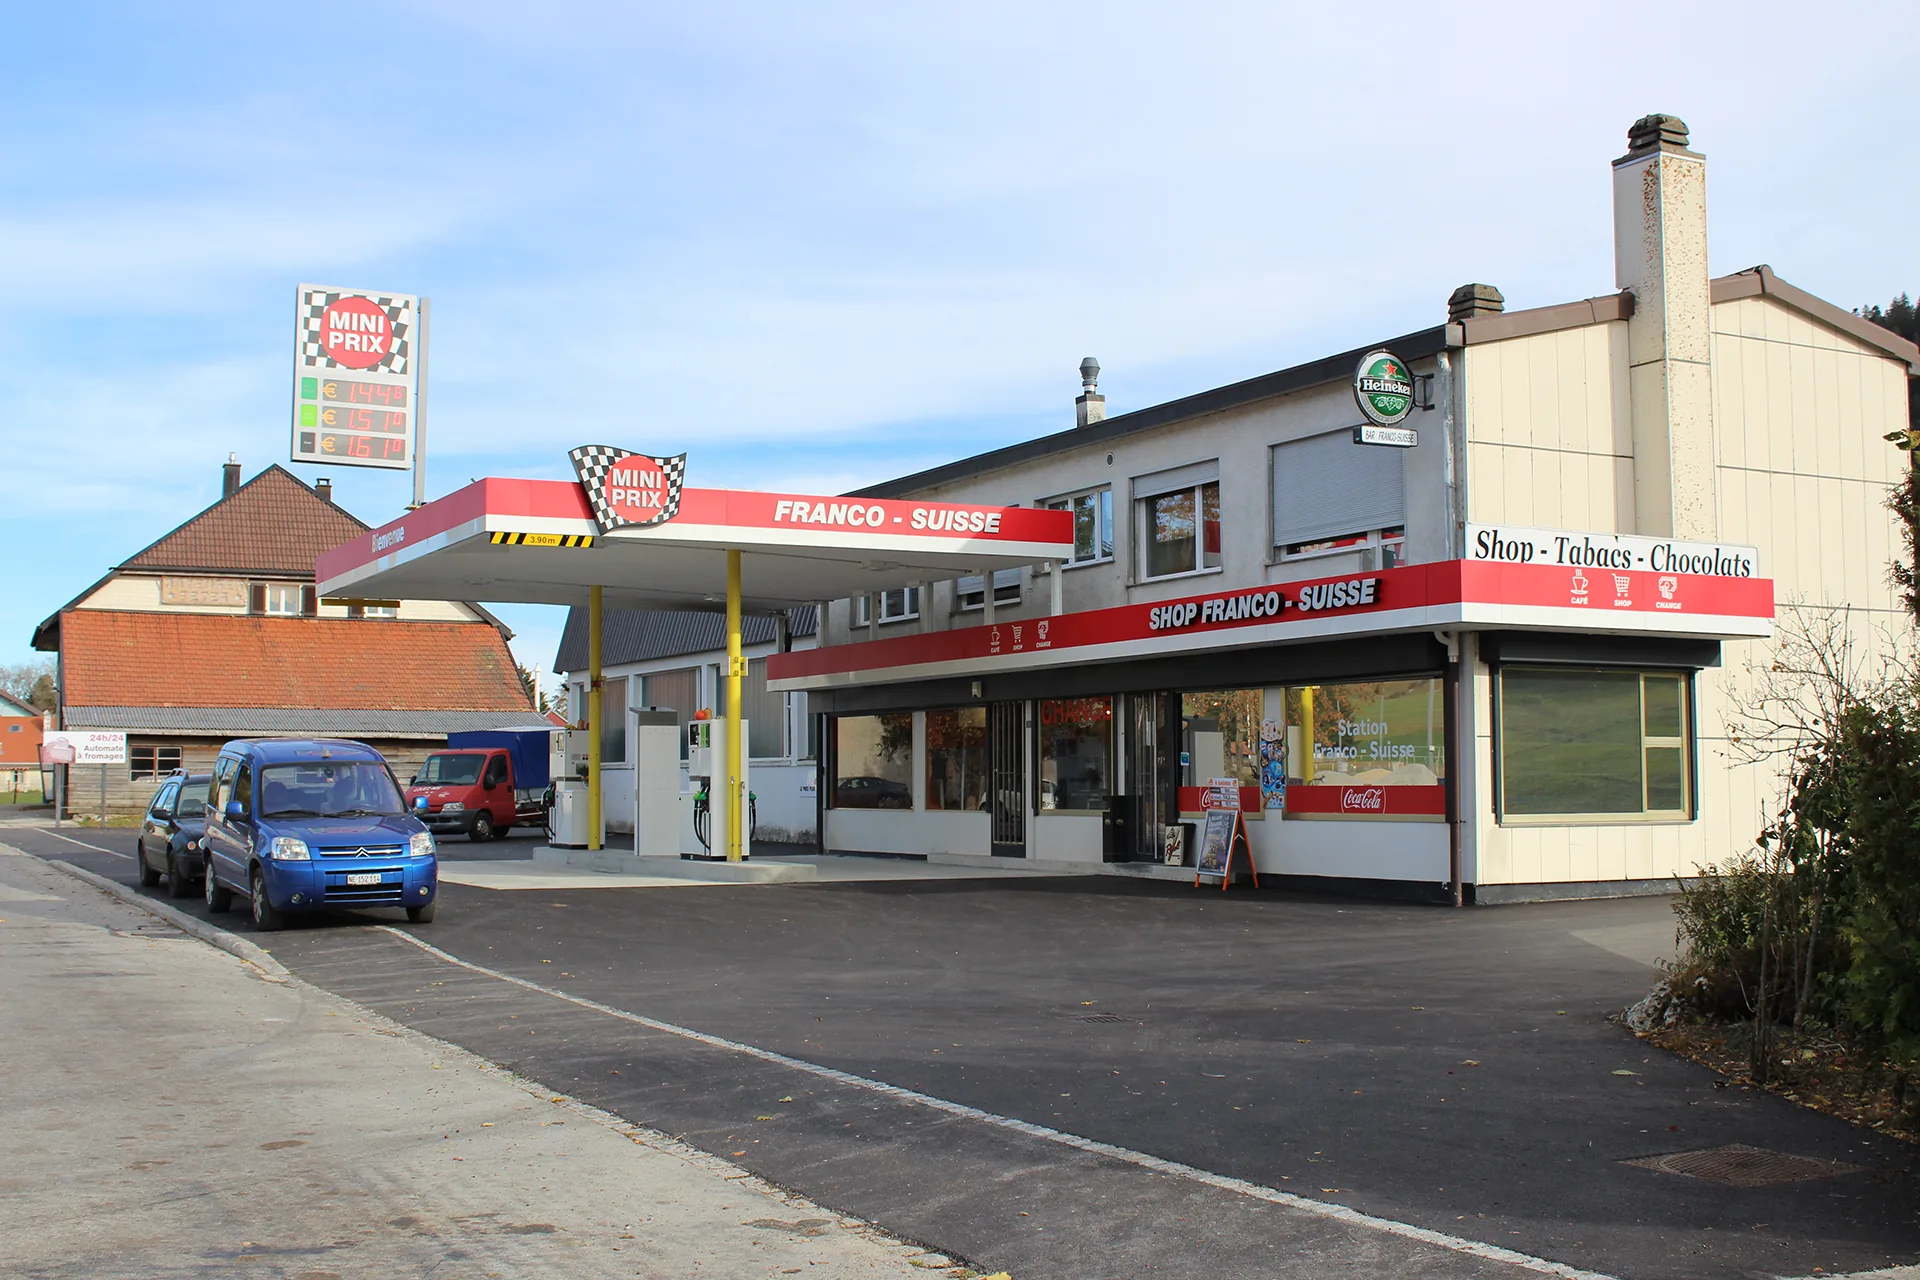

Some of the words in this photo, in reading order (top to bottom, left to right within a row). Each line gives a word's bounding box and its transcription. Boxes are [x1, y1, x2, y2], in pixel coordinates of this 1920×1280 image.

[329, 311, 384, 334] MINI
[328, 332, 384, 354] PRIX
[612, 468, 662, 489] MINI
[611, 488, 662, 509] PRIX
[774, 500, 885, 527] FRANCO
[910, 508, 1002, 534] SUISSE
[1475, 529, 1534, 563] Shop
[1554, 536, 1632, 570] Tabacs
[1650, 543, 1751, 578] Chocolats
[1149, 602, 1198, 630] SHOP
[1201, 591, 1280, 624] FRANCO
[1298, 578, 1377, 612] SUISSE
[1570, 596, 1589, 605] CAFÉ
[1613, 599, 1632, 607] SHOP
[1655, 601, 1682, 610] CHANGE
[1041, 696, 1112, 725] CHANGE
[89, 734, 124, 742] 24h/24
[1337, 719, 1388, 737] Station
[84, 752, 124, 761] fromages
[1314, 742, 1358, 759] Franco
[1369, 741, 1415, 759] Suisse
